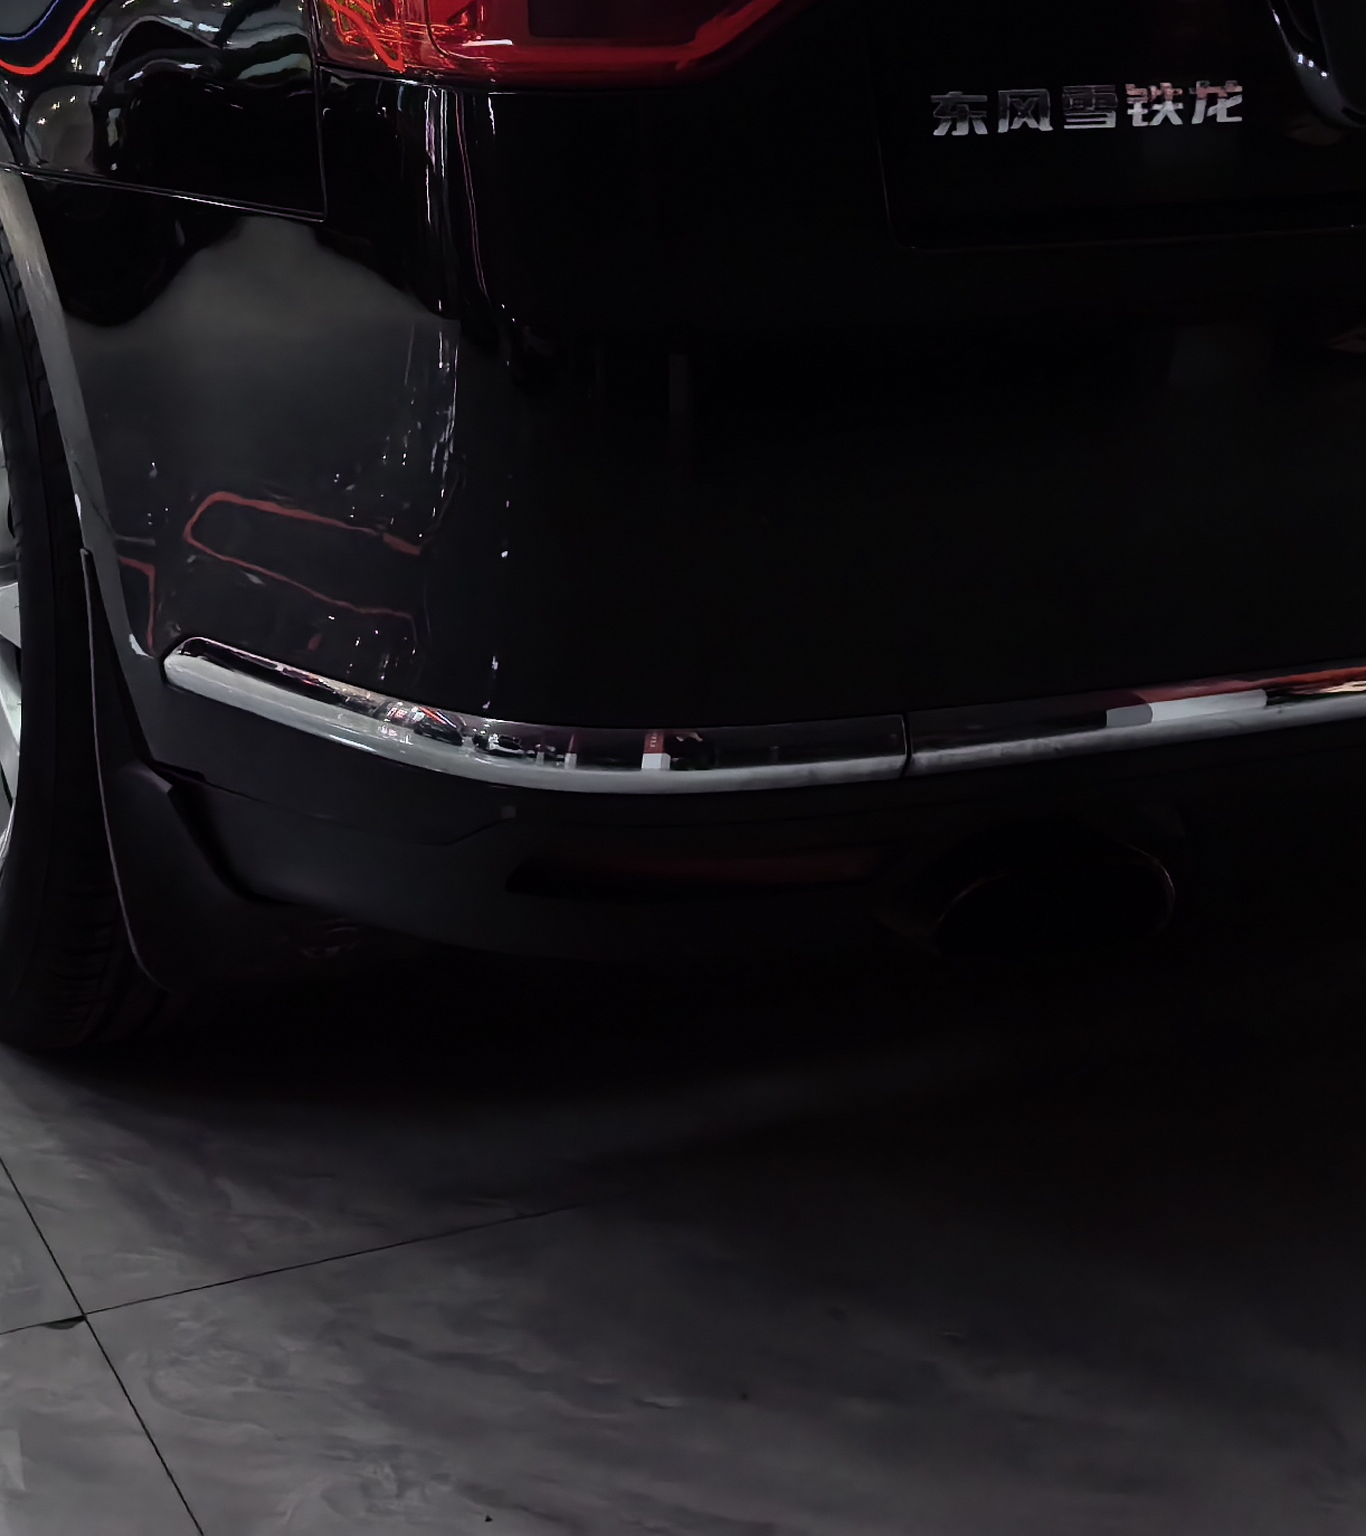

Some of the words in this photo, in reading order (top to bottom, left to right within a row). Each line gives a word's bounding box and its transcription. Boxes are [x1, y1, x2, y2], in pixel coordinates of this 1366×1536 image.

[930, 80, 1243, 136] 东风雪铁龙
